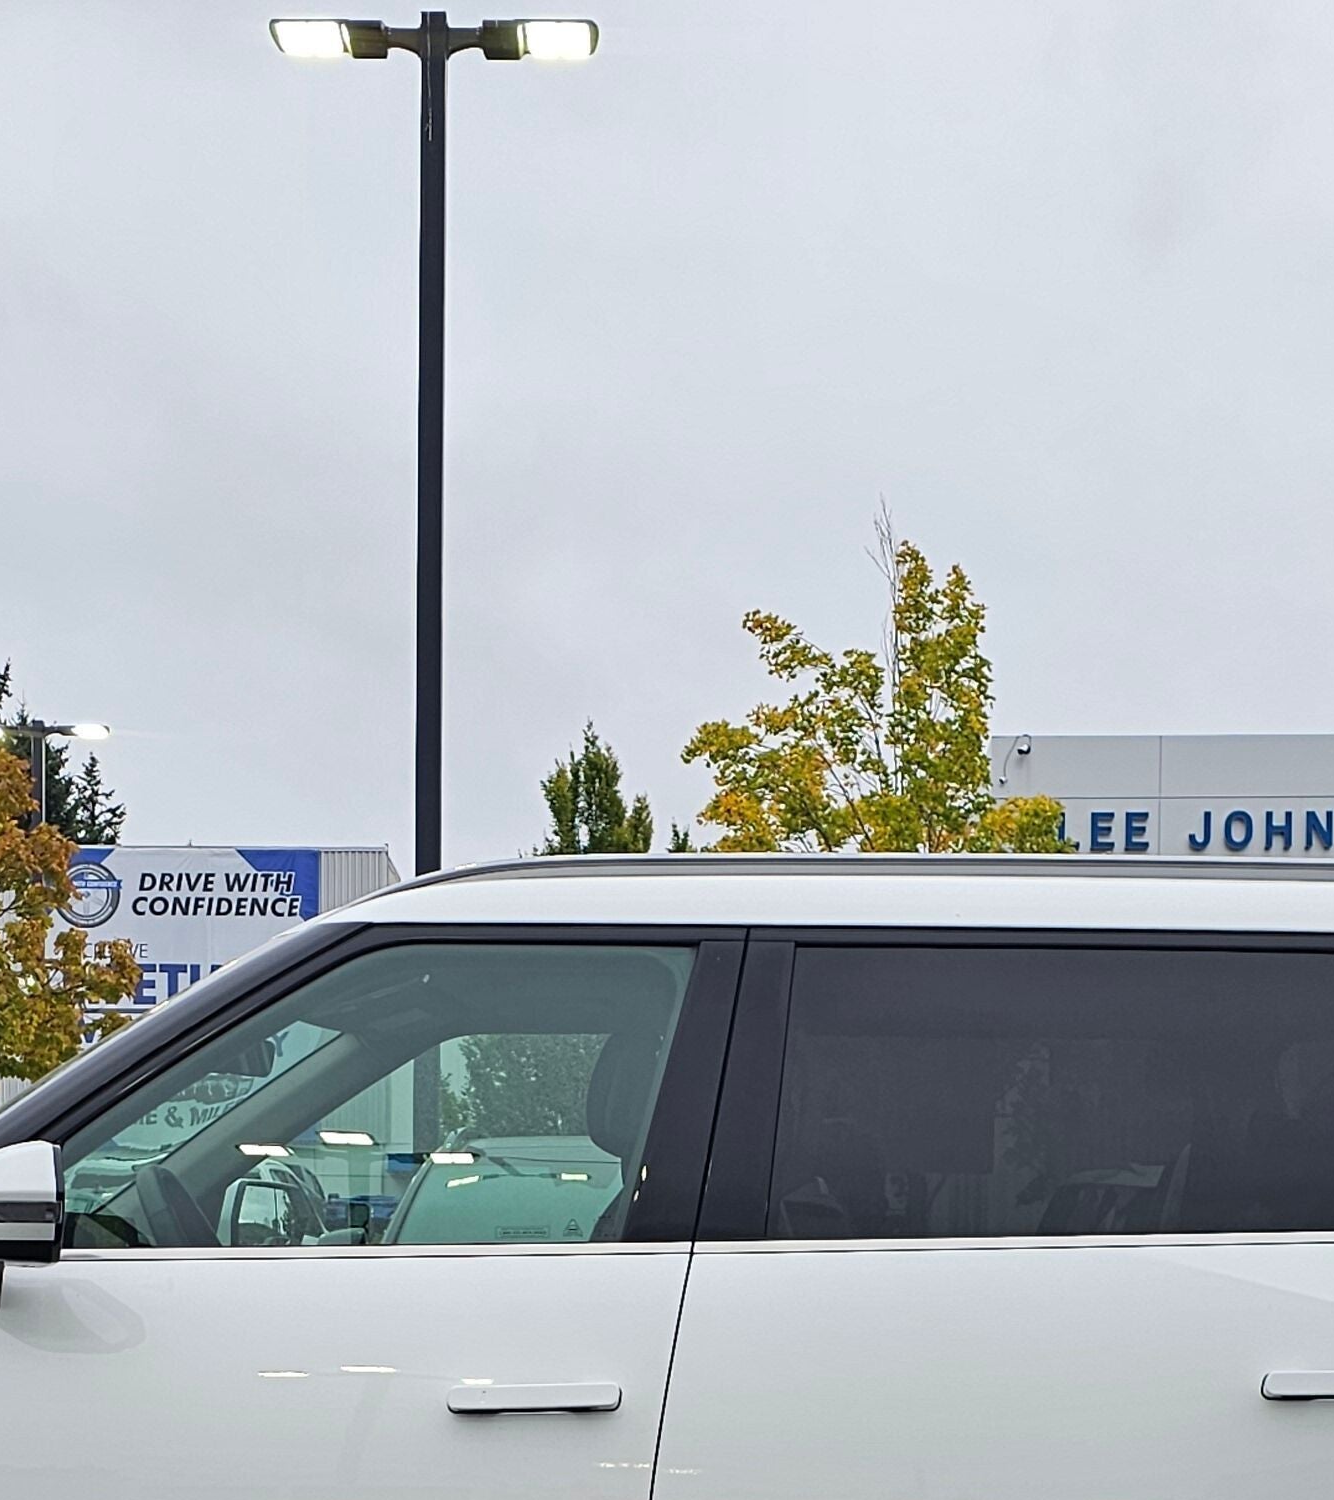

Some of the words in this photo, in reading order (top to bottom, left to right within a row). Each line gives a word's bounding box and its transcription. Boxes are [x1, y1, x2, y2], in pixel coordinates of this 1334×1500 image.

[1057, 811, 1150, 852] LEE
[138, 872, 216, 893] DRIVE
[224, 872, 295, 893] WITH
[131, 896, 301, 917] CONFIDENCE
